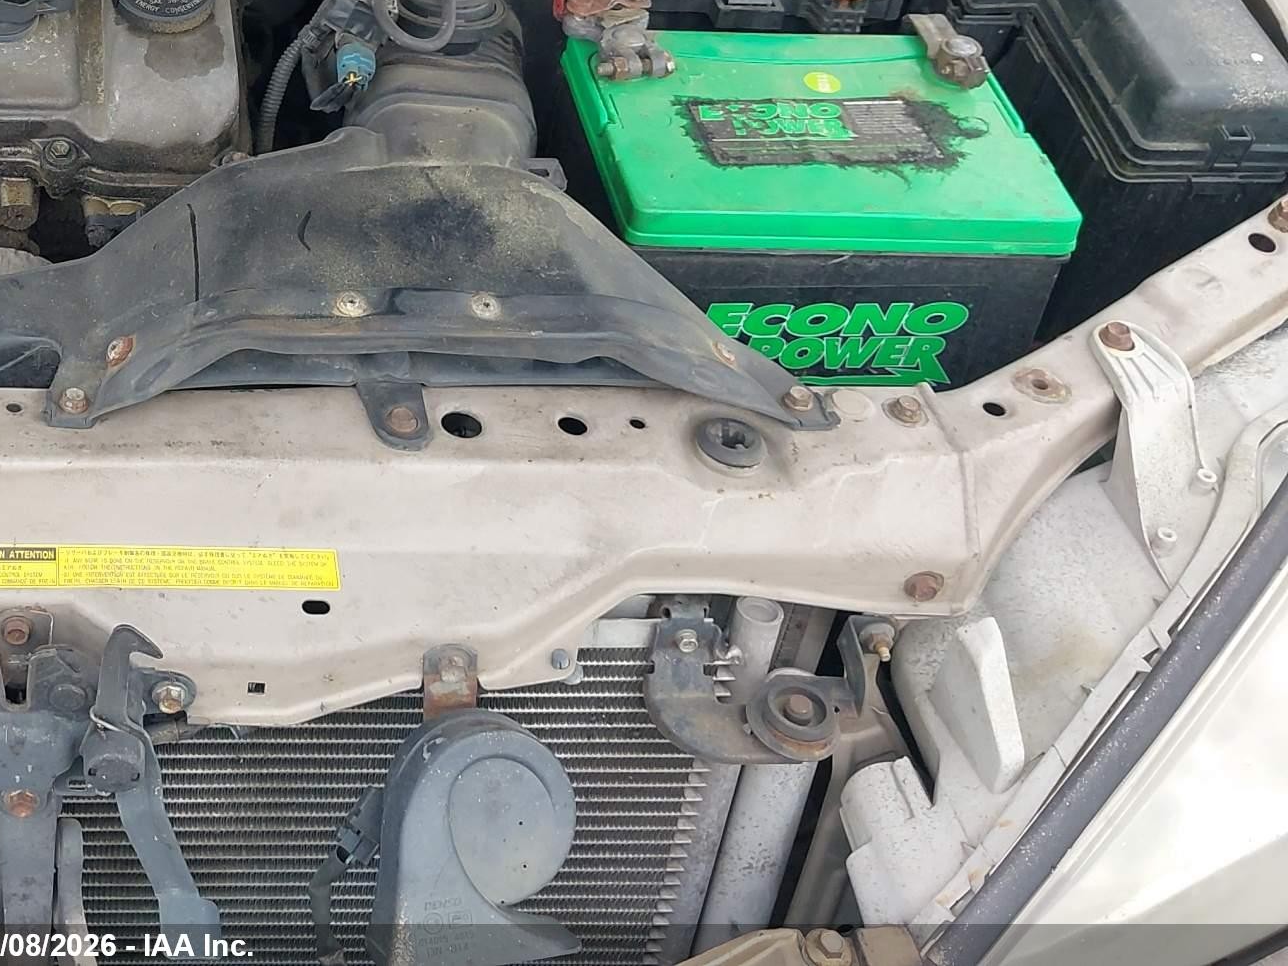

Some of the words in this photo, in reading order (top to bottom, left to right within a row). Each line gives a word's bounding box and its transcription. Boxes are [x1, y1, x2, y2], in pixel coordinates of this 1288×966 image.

[706, 301, 969, 337] ECONO
[747, 336, 948, 374] POWER
[9, 550, 55, 560] ATTENTION
